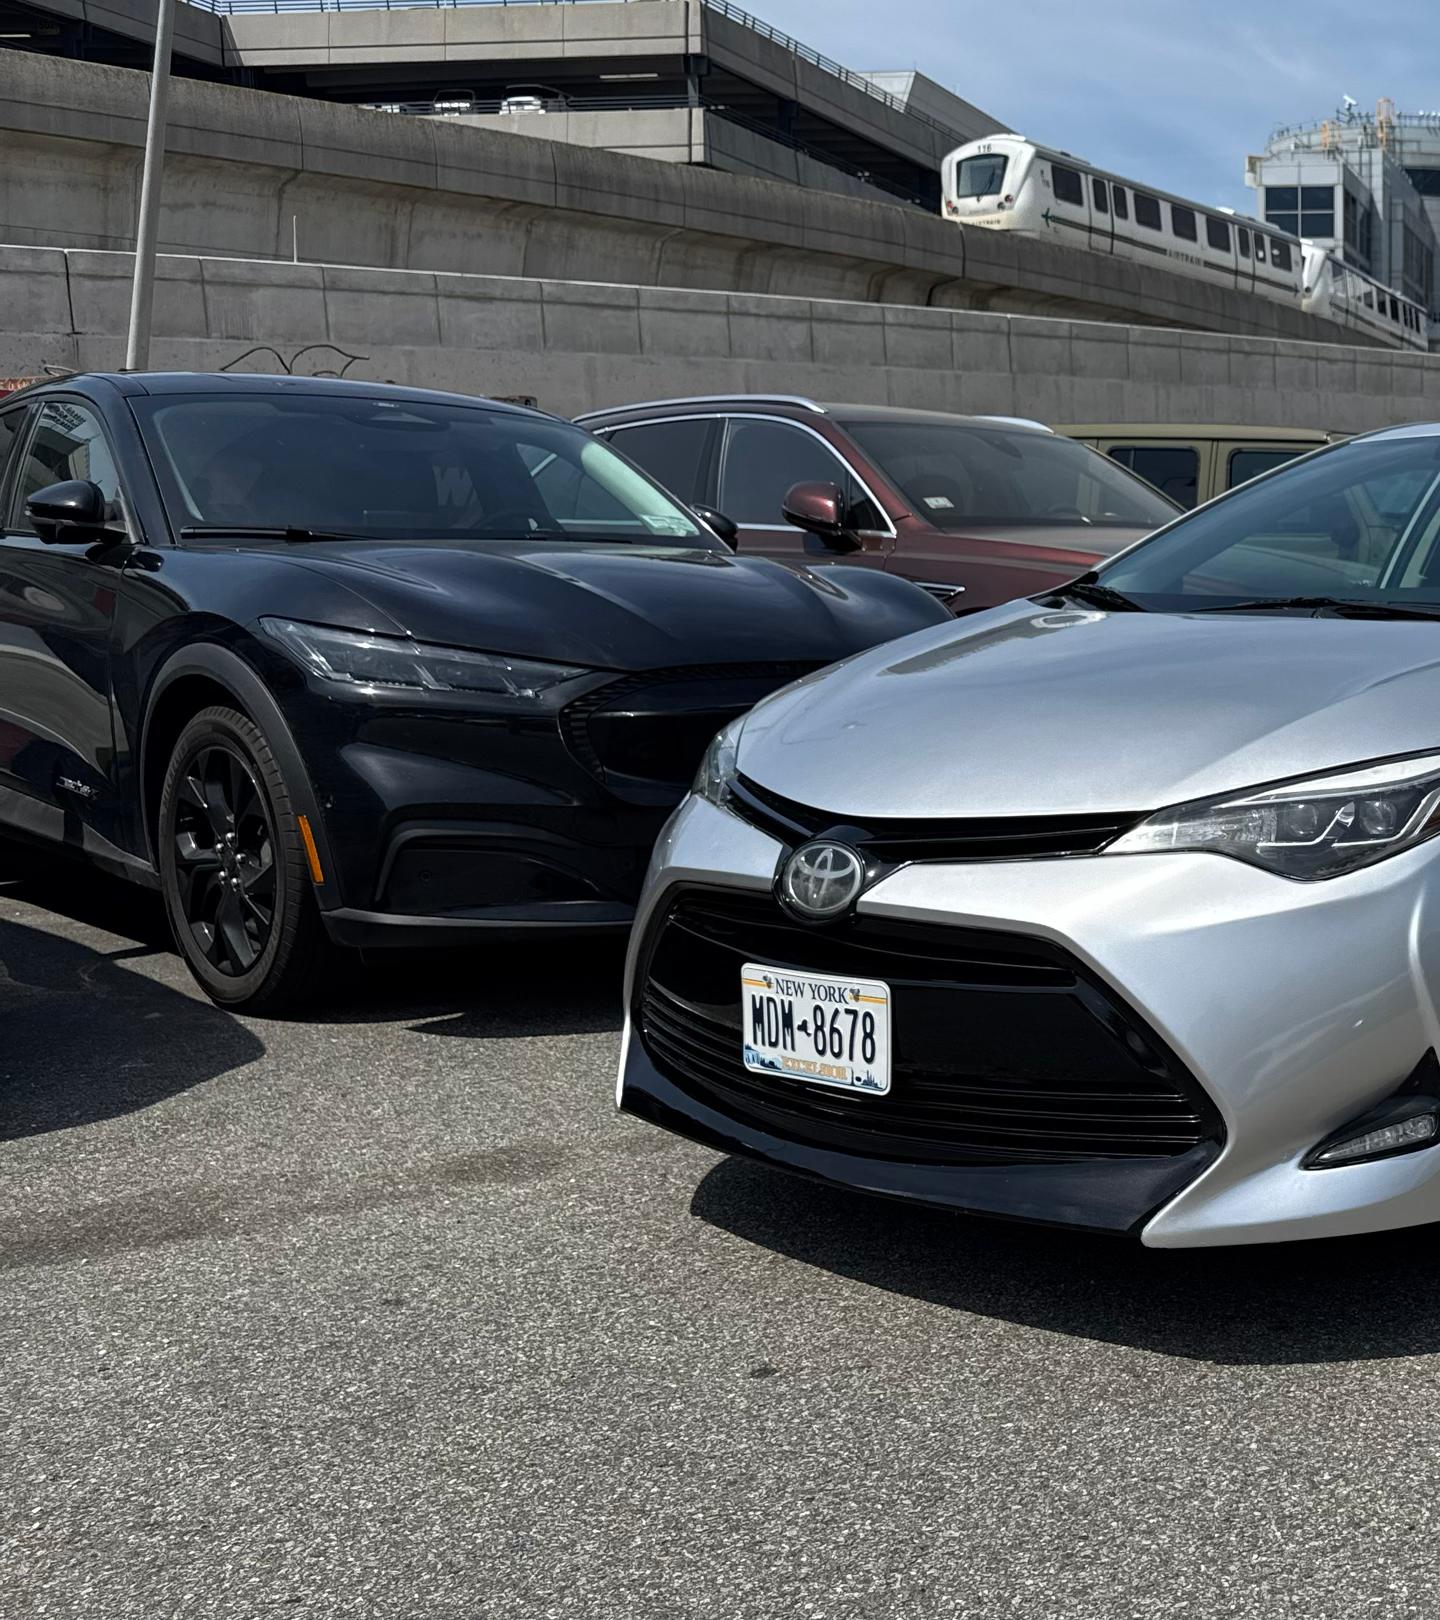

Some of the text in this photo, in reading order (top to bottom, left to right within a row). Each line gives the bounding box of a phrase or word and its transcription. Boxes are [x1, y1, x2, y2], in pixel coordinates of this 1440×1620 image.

[774, 977, 850, 1005] NEW YORK
[752, 994, 876, 1064] MDM 8678
